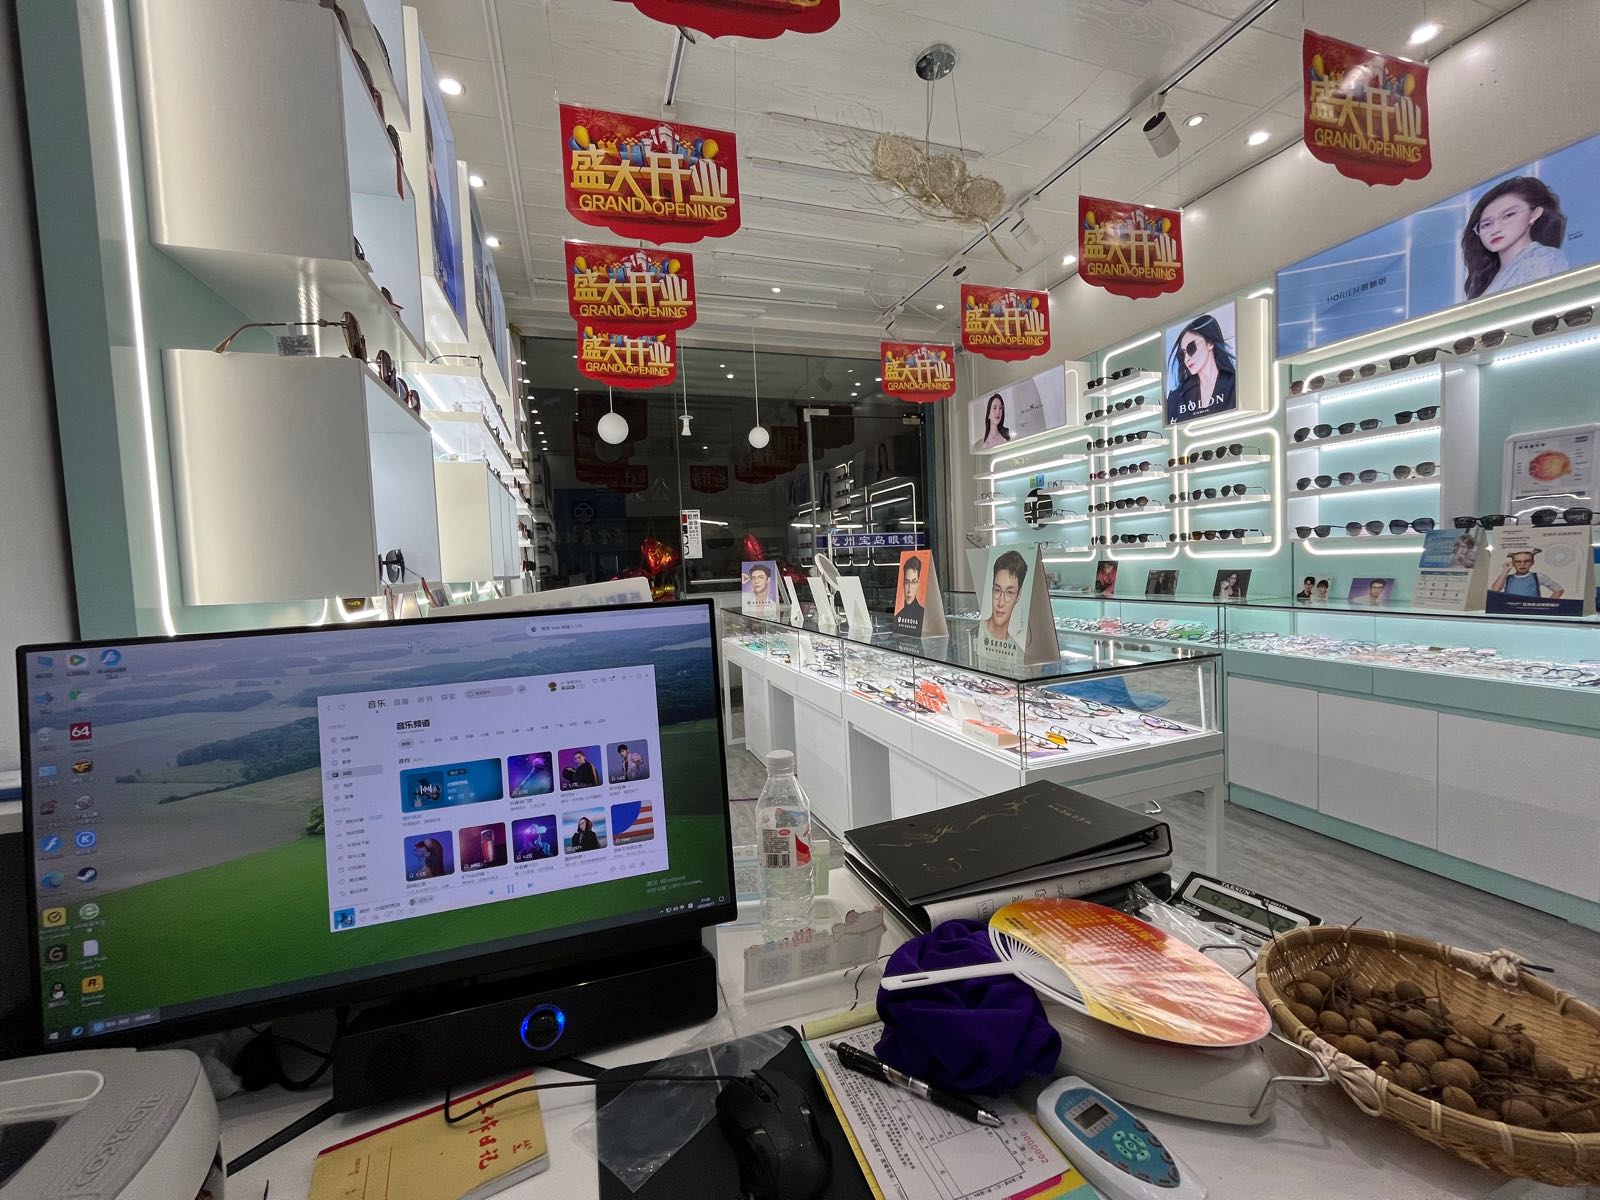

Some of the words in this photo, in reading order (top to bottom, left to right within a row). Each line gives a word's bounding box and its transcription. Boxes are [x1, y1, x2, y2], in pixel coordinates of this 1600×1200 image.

[1309, 75, 1427, 148] 盛大开业
[1314, 128, 1361, 150] GRAND
[1367, 139, 1421, 162] OPENING
[571, 144, 735, 211] 盛大开业
[579, 194, 645, 213] GRAND
[652, 201, 727, 220] OPENING
[1083, 224, 1181, 274] 盛大开业
[1087, 263, 1126, 275] GRAND
[1131, 267, 1176, 279] OPENING
[574, 269, 693, 314] 盛大开业
[580, 304, 626, 317] GRAND
[632, 306, 688, 318] OPENING
[965, 306, 1048, 342] 盛大开业
[969, 334, 1001, 345] GRAND
[1006, 335, 1044, 346] OPENING
[582, 335, 674, 371] 盛大开业
[586, 362, 622, 372] GRAND
[627, 366, 669, 376] OPENING
[885, 357, 953, 388] 盛大开业
[888, 382, 915, 391] GRAND
[919, 382, 950, 391] OPENING
[991, 640, 1017, 651] SEROVA
[368, 699, 386, 709] 音乐
[71, 726, 90, 737] 64
[396, 719, 430, 731] 音乐频道
[1220, 882, 1250, 896] TAKSUN
[1020, 1131, 1049, 1165] 0000002
